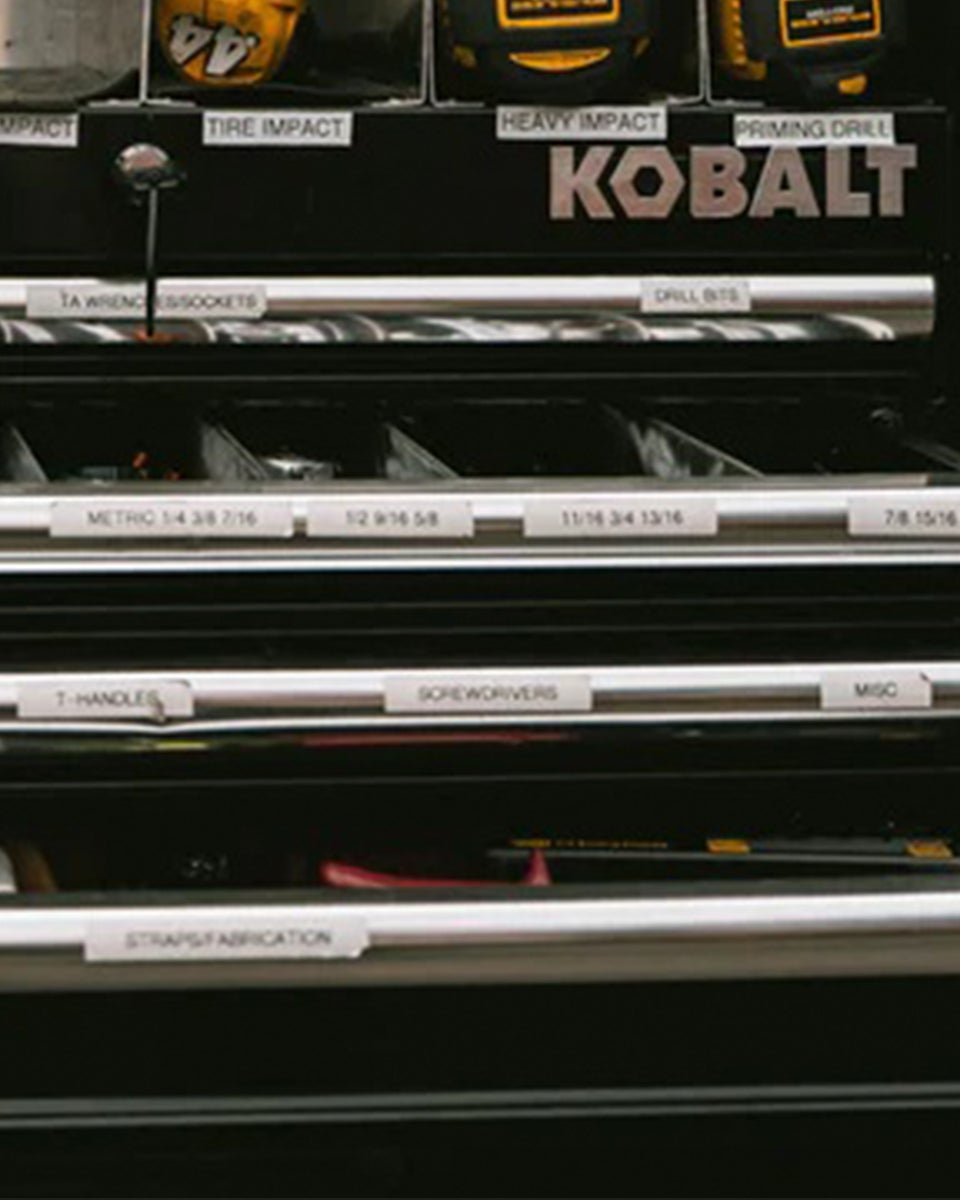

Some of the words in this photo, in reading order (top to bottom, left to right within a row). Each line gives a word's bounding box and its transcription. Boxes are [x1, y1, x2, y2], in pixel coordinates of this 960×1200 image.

[208, 117, 254, 138] TIRE
[262, 117, 344, 138] IMPACT
[502, 110, 573, 132] HEAVY
[580, 110, 660, 132] IMPACT
[737, 118, 826, 140] PRIMING
[831, 117, 889, 138] DRILL
[549, 143, 917, 219] KOBALT
[87, 510, 155, 526] METRIC
